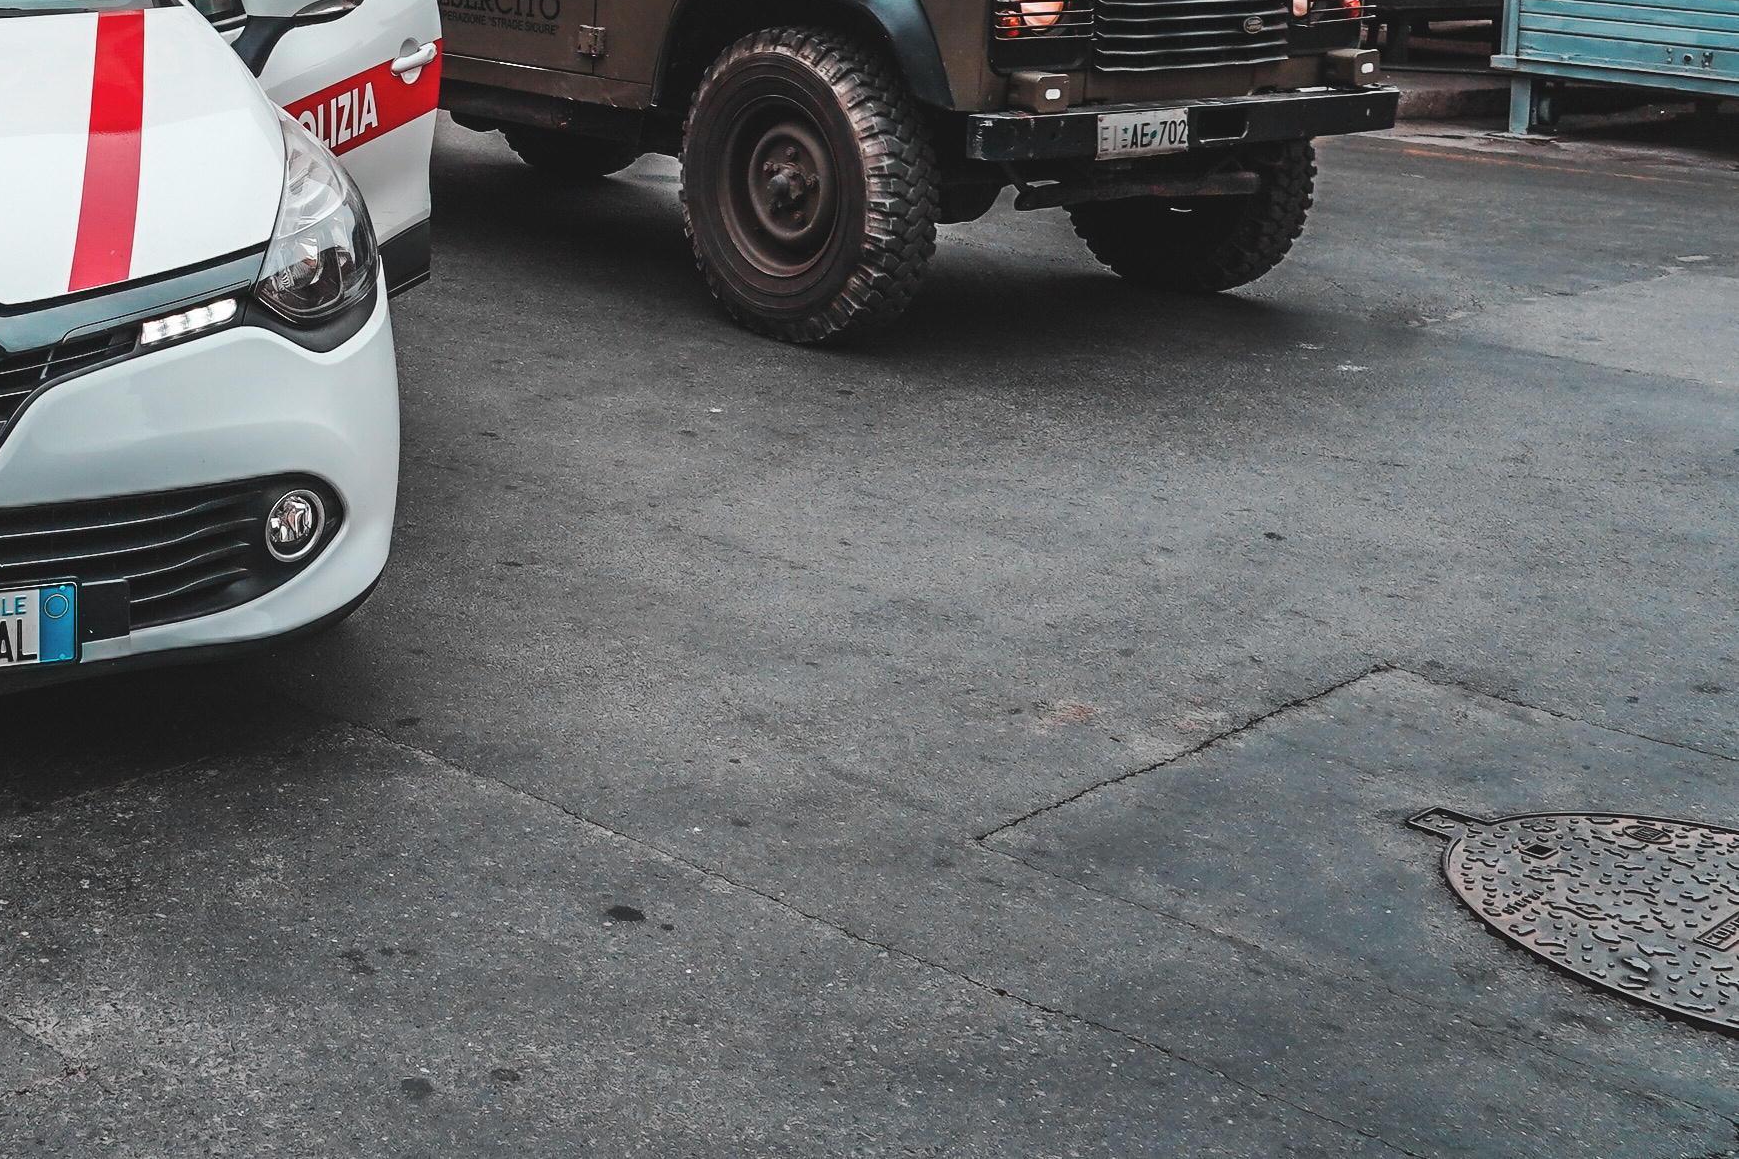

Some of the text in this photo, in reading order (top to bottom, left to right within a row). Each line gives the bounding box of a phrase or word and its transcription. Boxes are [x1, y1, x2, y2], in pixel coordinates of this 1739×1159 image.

[441, 9, 487, 26] PERAZIONE
[298, 81, 379, 148] OLIZIA
[1129, 122, 1153, 149] AE
[1158, 119, 1187, 146] 702
